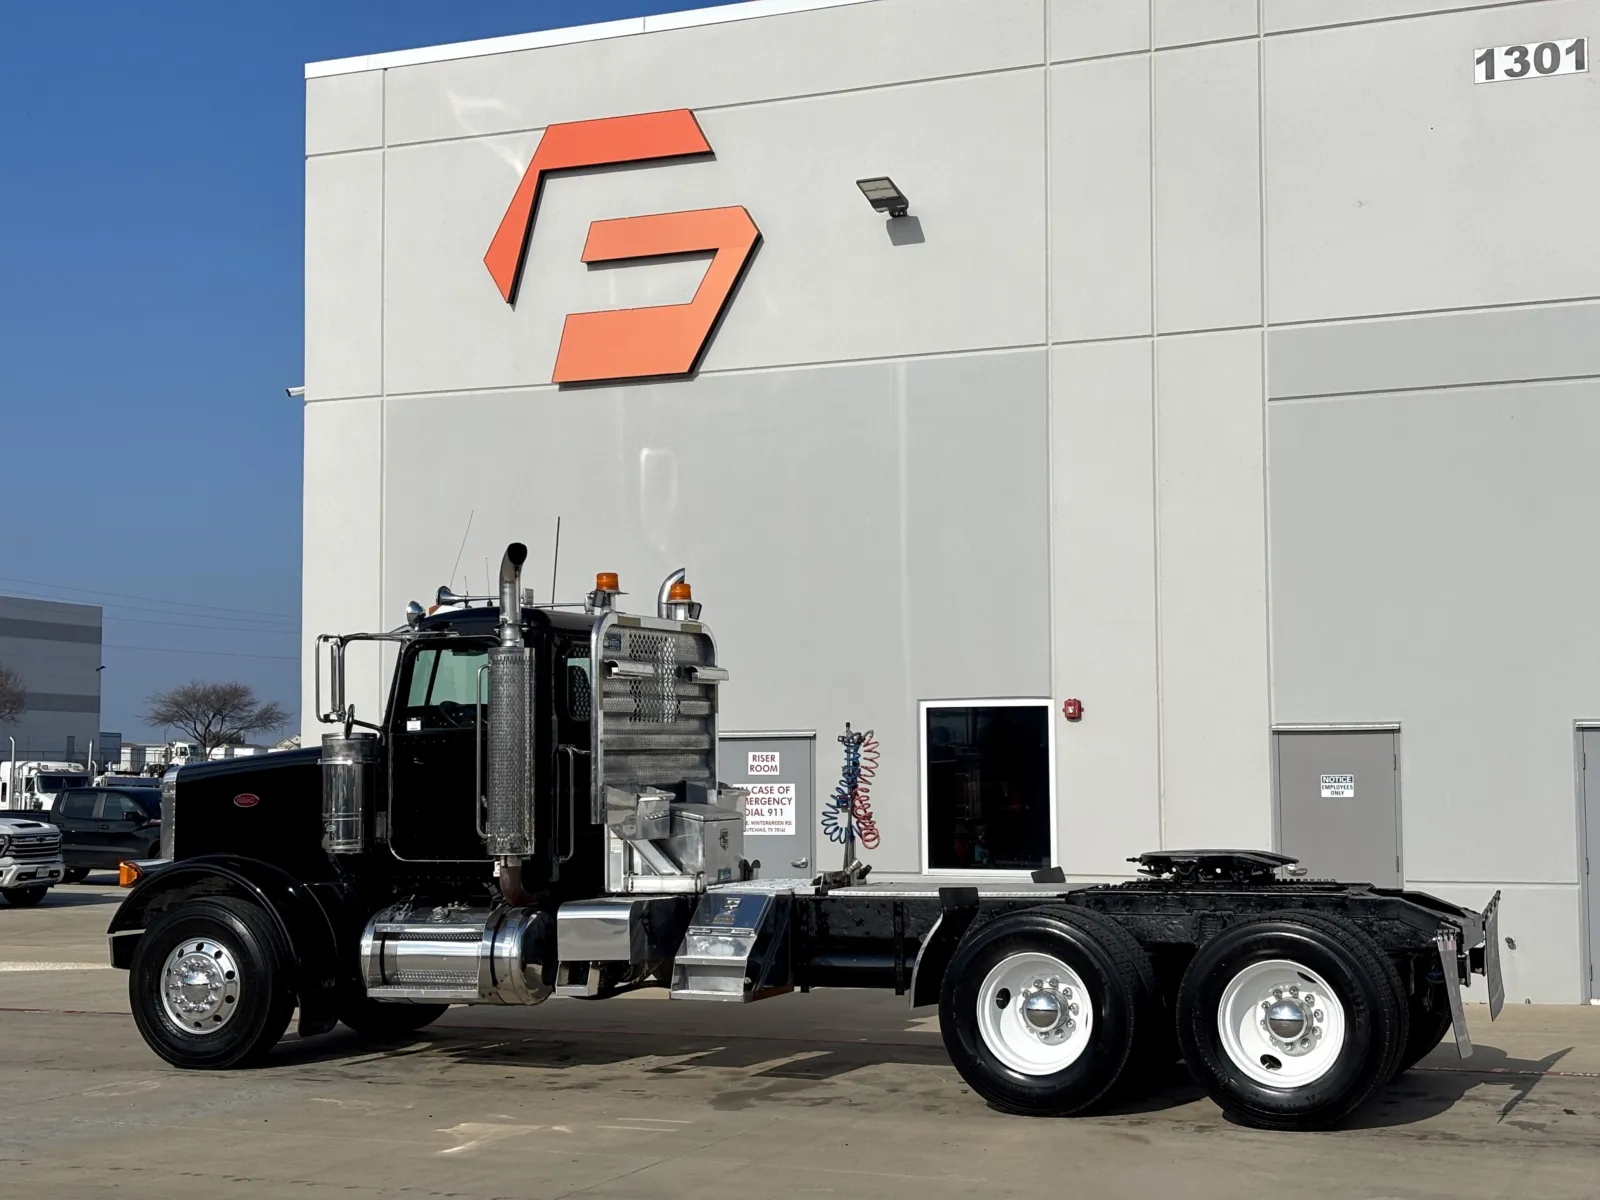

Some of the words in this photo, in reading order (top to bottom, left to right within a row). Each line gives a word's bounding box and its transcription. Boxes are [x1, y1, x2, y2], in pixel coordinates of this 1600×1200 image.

[1475, 38, 1586, 81] 1301
[752, 754, 776, 763] RISER
[749, 764, 778, 773] ROOM
[751, 786, 775, 795] CASE
[777, 786, 791, 795] OF
[745, 797, 793, 806] ERGENCY
[745, 808, 765, 817] DIAL
[767, 808, 784, 817] 911
